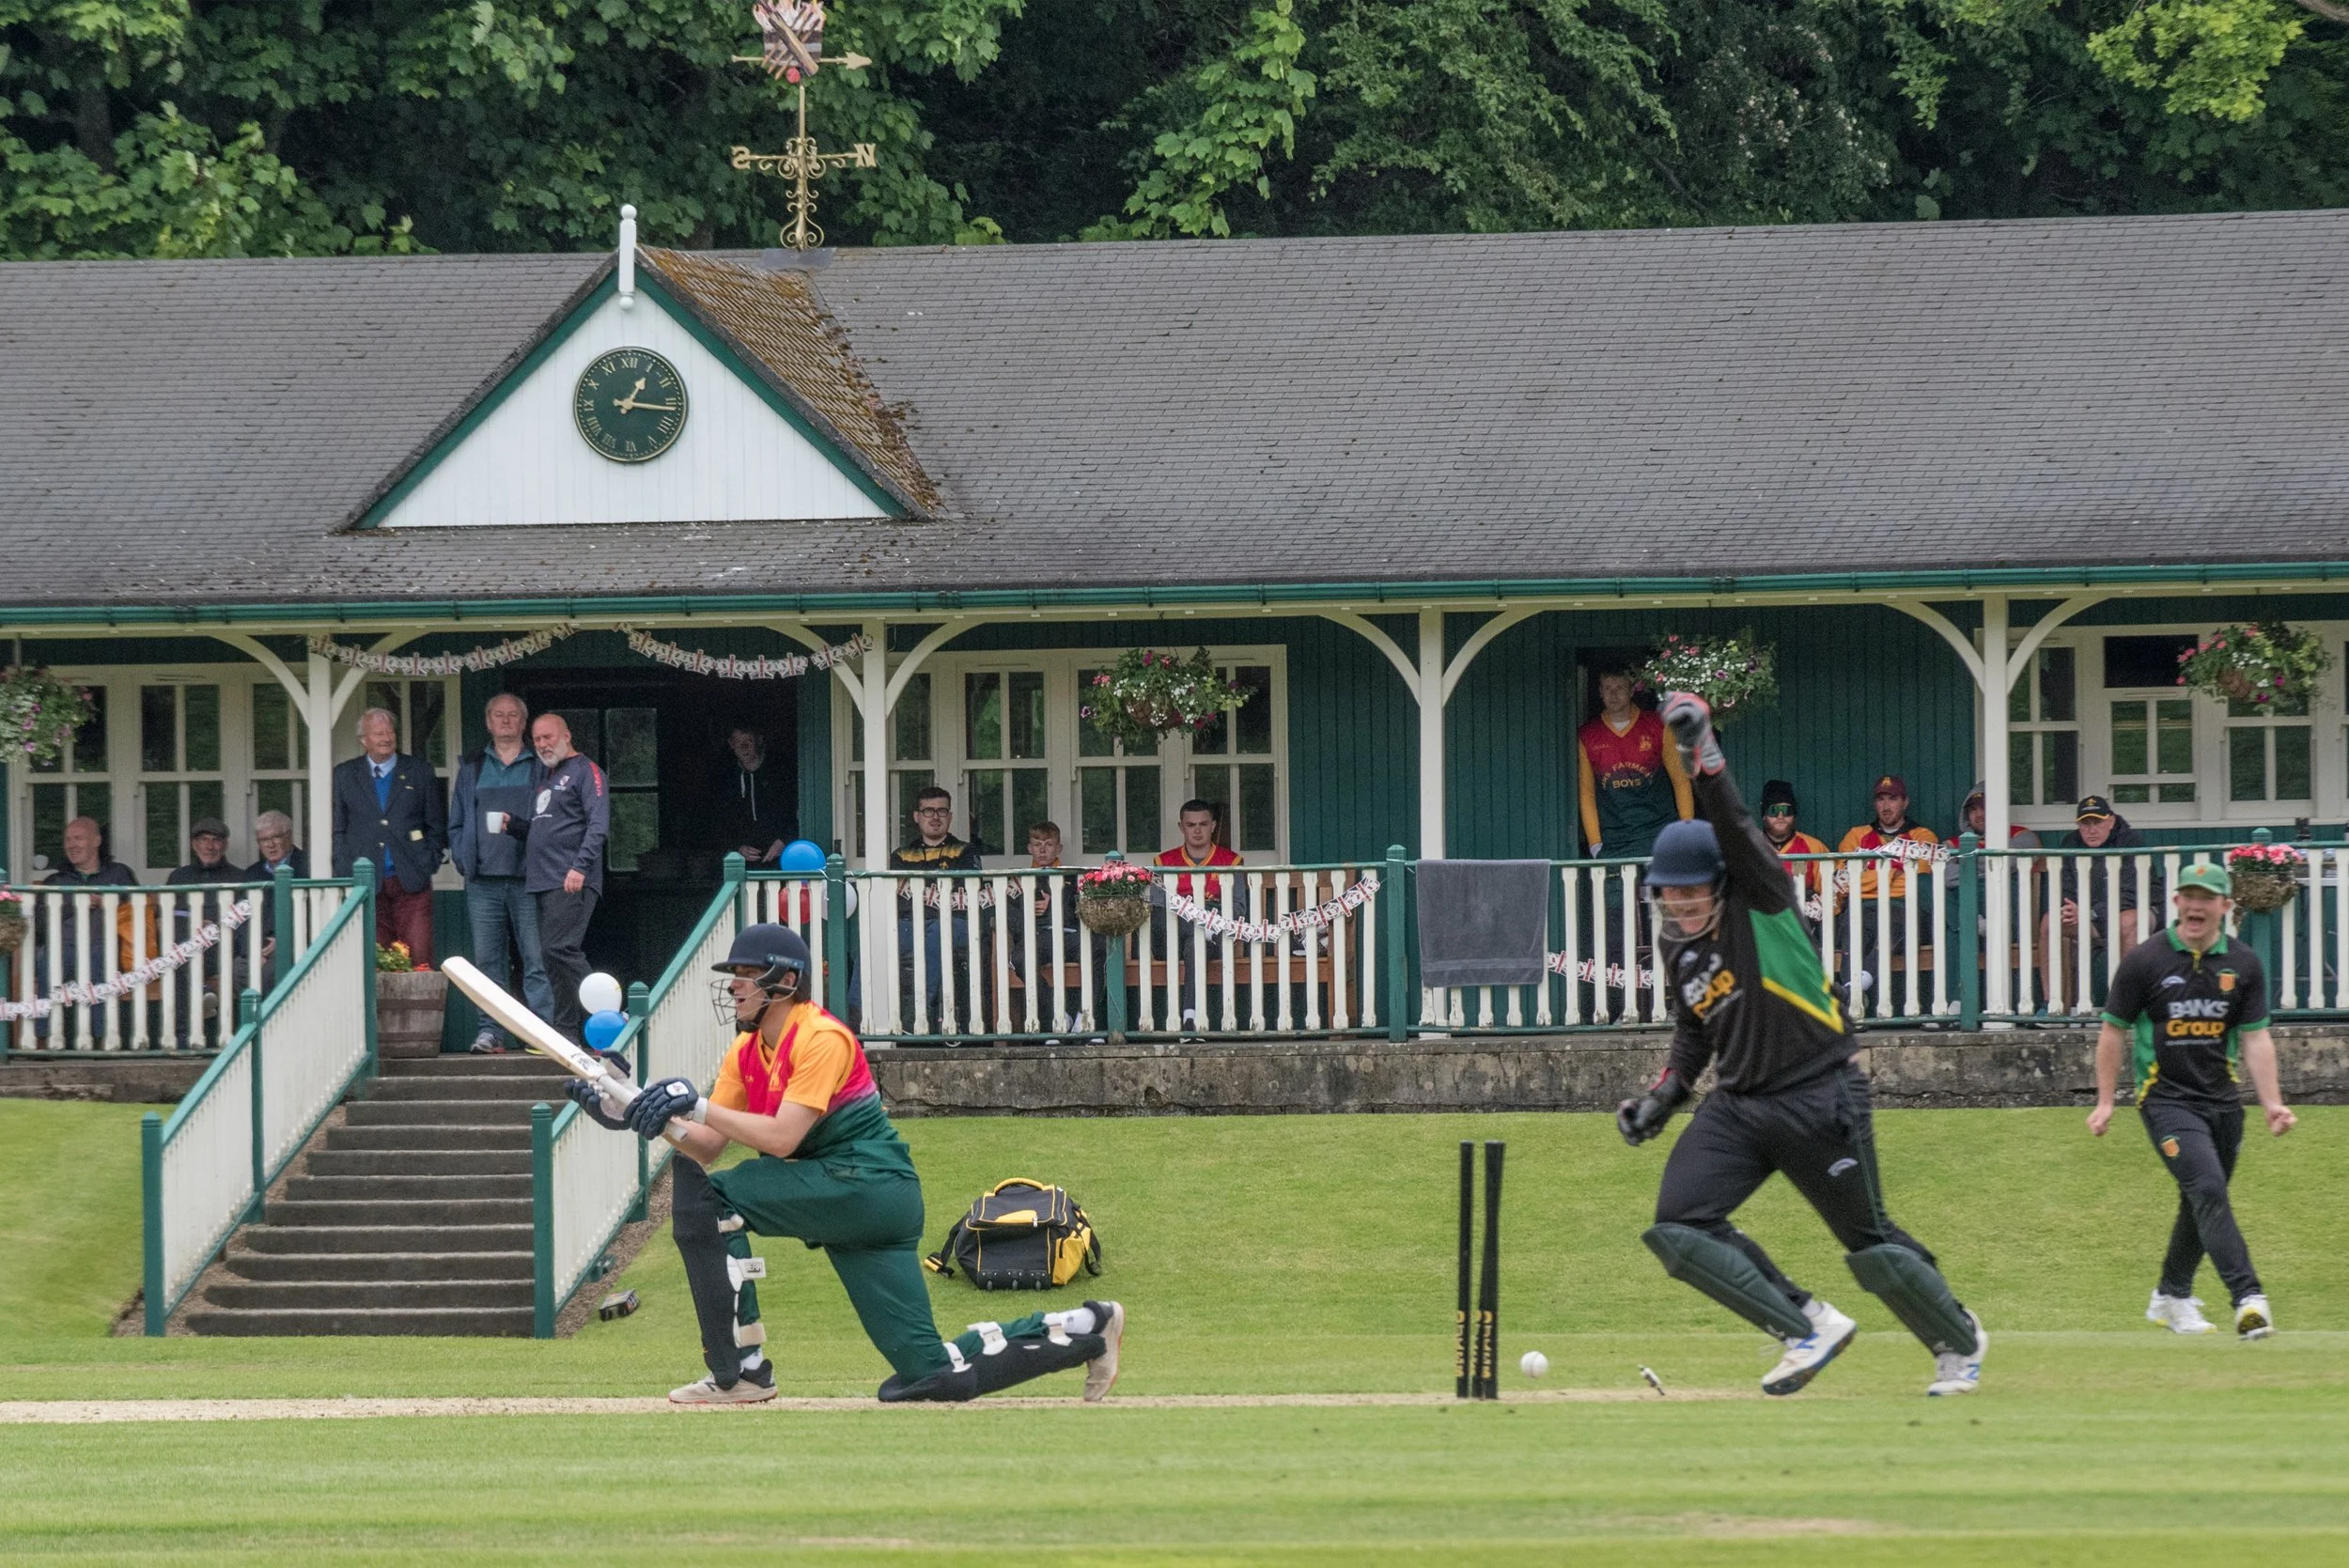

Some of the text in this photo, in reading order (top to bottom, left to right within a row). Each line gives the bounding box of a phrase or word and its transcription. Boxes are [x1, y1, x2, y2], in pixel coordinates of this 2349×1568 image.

[853, 143, 877, 168] N
[1612, 779, 1641, 789] BOYS
[2167, 999, 2230, 1018] BANKS
[2166, 1019, 2226, 1038] Group
